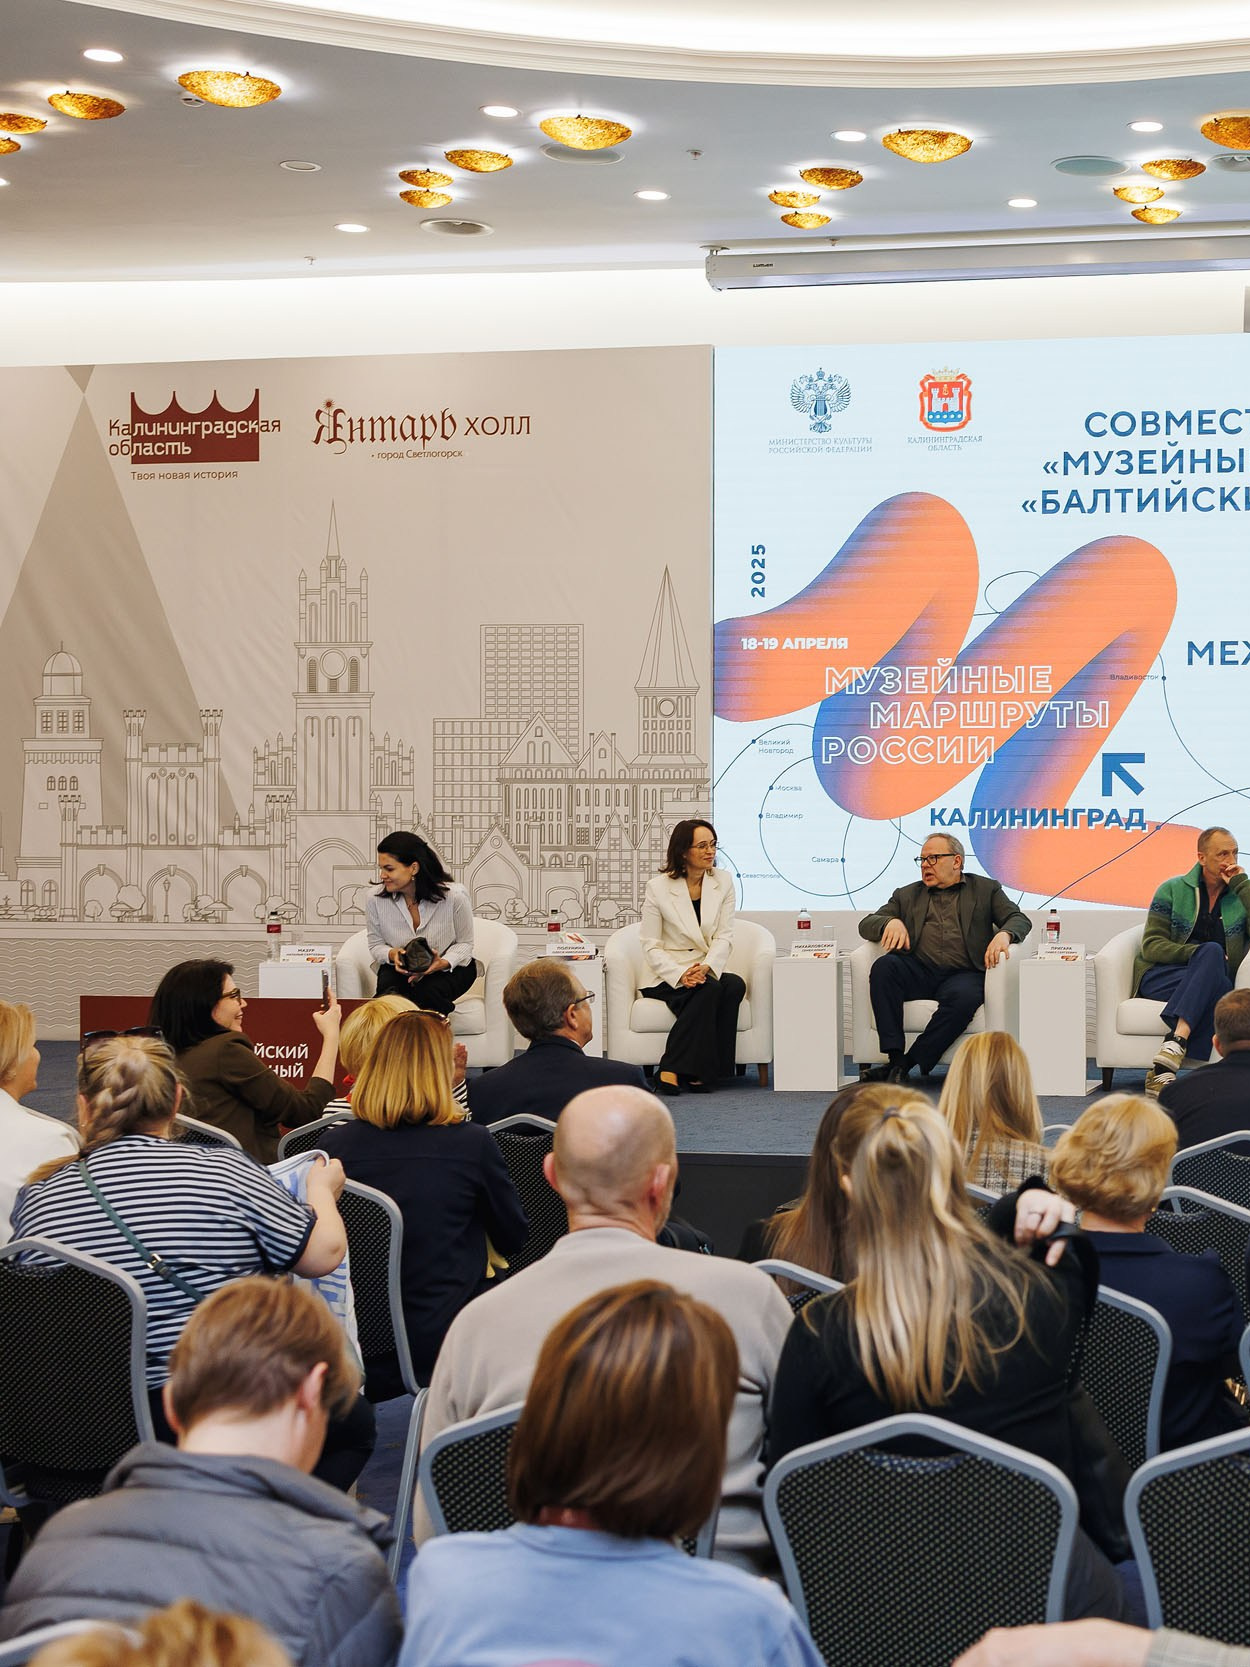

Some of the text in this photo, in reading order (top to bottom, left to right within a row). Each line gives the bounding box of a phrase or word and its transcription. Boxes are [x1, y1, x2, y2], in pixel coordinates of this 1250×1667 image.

[108, 418, 282, 440] Калининградская
[311, 400, 458, 455] Янтарь
[108, 438, 193, 457] область
[376, 449, 464, 461] город Светлогорск
[131, 470, 239, 481] Твоя новая история
[750, 543, 767, 599] 2025
[741, 637, 849, 651] 18-19 АПРЕЛЯ
[824, 657, 1053, 695] МУЗЕЙНЫЕ
[869, 700, 1110, 730] МАРШРУТЫ
[758, 747, 795, 755] Новгород
[821, 735, 995, 765] РОССИИ
[765, 812, 804, 820] Владимир
[929, 807, 1148, 834] КАЛИНИНГРАД
[811, 856, 840, 864] Самара
[253, 1042, 309, 1059] ЙСКИЙ
